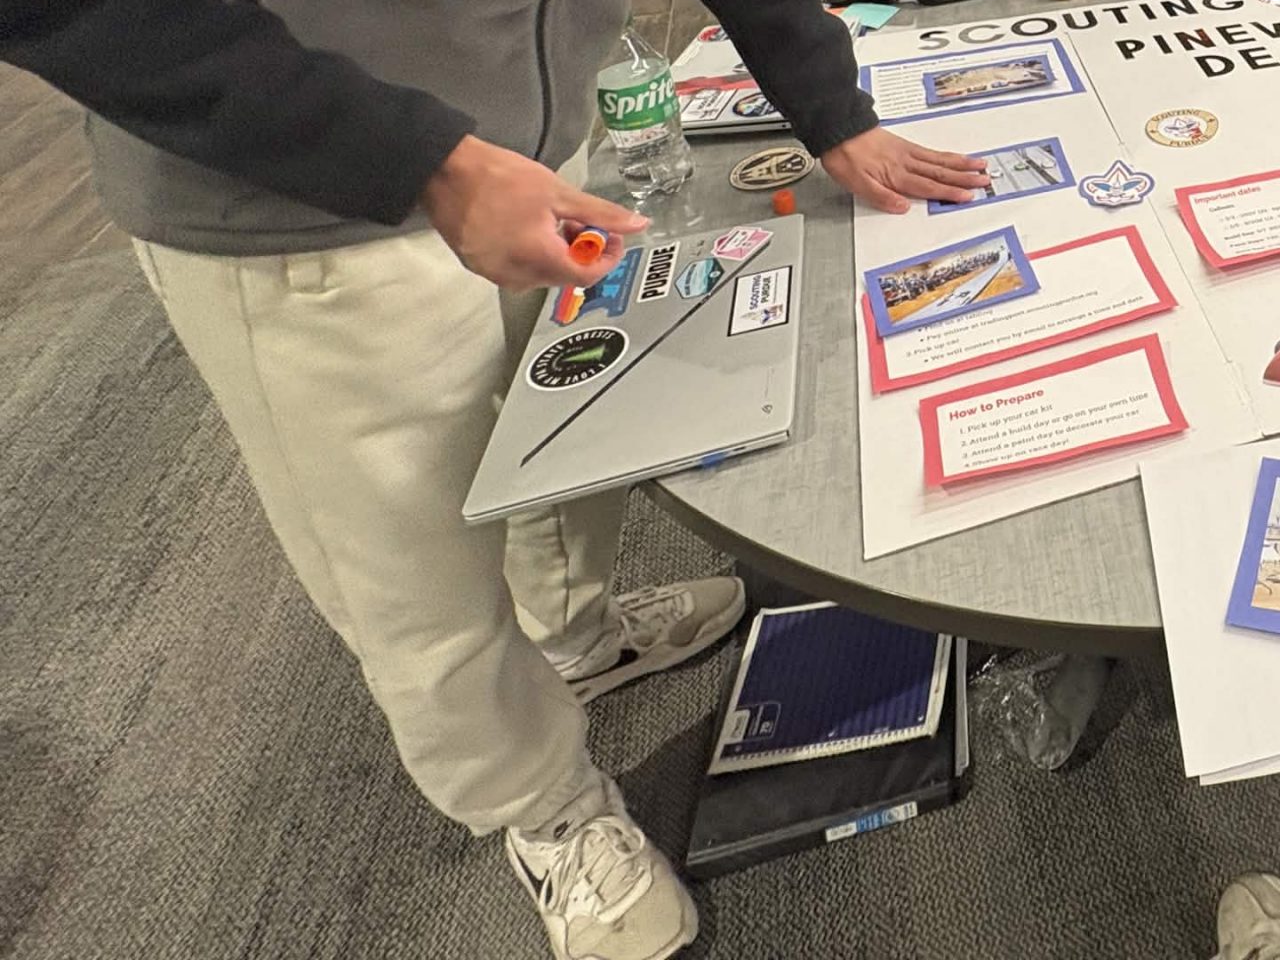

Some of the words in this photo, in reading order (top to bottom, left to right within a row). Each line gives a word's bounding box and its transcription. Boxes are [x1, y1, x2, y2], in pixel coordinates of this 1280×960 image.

[602, 77, 675, 120] Sprite
[1194, 191, 1236, 205] Important
[1237, 186, 1262, 197] dates
[641, 242, 676, 301] PURDUE
[749, 273, 762, 311] SCOUTING
[760, 273, 773, 305] PURDUE
[568, 330, 616, 345] FORESTS
[926, 332, 942, 342] Pay
[943, 325, 970, 336] online
[946, 346, 962, 357] will
[963, 338, 995, 352] contact
[996, 334, 1011, 344] you
[1023, 324, 1046, 335] email
[1056, 312, 1086, 327] arrange
[1093, 305, 1111, 315] time
[1112, 300, 1126, 309] and
[1127, 295, 1144, 305] date
[536, 344, 565, 369] STATE
[913, 345, 933, 356] Pick
[946, 337, 960, 347] car
[564, 368, 596, 385] LOVE
[949, 406, 978, 421] How
[980, 401, 994, 413] to
[995, 388, 1045, 410] Prepare
[967, 421, 987, 433] Pick
[988, 418, 1002, 428] up
[1002, 412, 1022, 424] your
[1024, 408, 1039, 417] car
[1040, 403, 1053, 413] kit
[969, 430, 1000, 445] Attend
[1008, 423, 1032, 435] build
[1033, 419, 1050, 430] day
[1062, 413, 1074, 423] go
[1074, 409, 1087, 419] on
[1087, 403, 1108, 415] your
[1108, 399, 1129, 409] own
[1128, 391, 1149, 403] time
[971, 443, 1002, 457] Attend
[1011, 435, 1035, 448] paint
[1036, 431, 1053, 441] day
[1065, 418, 1103, 433] decorate
[1105, 413, 1124, 424] your
[1125, 408, 1140, 418] car
[1028, 444, 1048, 454] race
